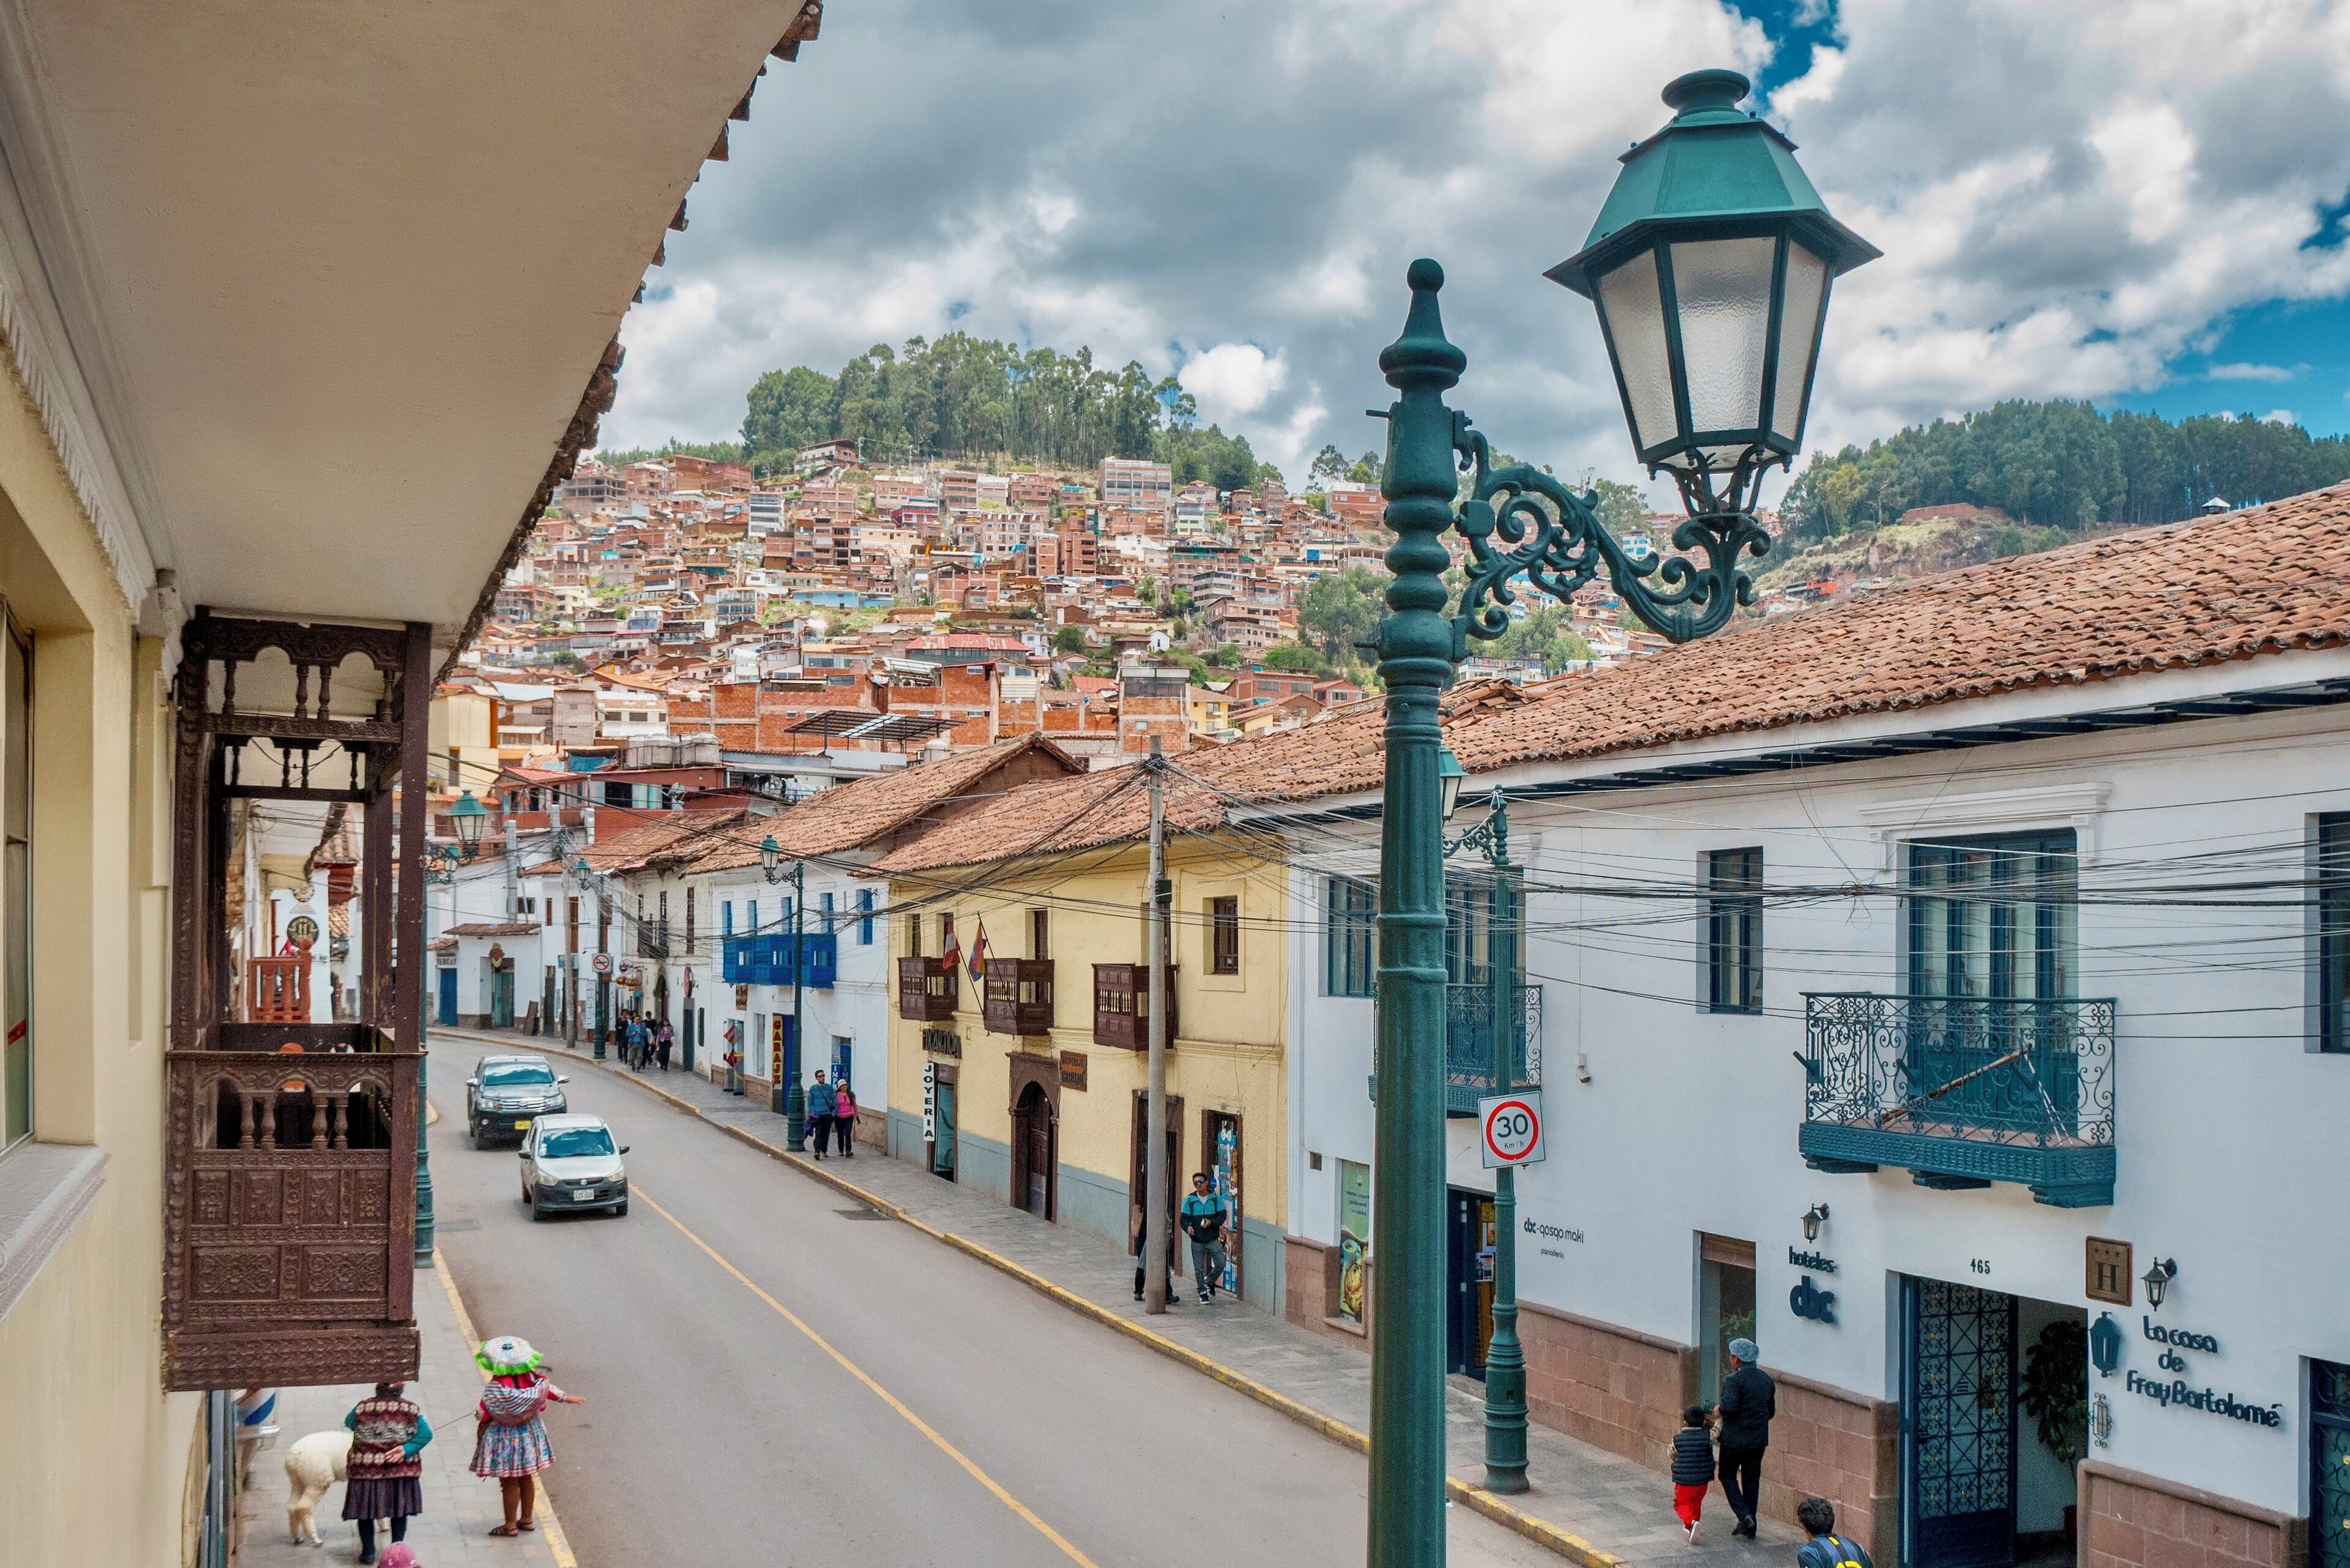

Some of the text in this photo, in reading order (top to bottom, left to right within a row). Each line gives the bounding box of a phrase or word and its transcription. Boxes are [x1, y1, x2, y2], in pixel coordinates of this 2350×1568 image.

[773, 1020, 781, 1085] GARAJE
[923, 1064, 934, 1138] JOYERIA
[1497, 1113, 1529, 1138] 30
[1565, 1228, 1584, 1244] maki
[1788, 1245, 1835, 1273] hoteles
[1969, 1258, 1990, 1275] 465
[2094, 1261, 2119, 1294] H
[2168, 1329, 2218, 1353] casa
[2158, 1348, 2185, 1372] de
[2126, 1370, 2283, 1427] Fray Bartolomé
